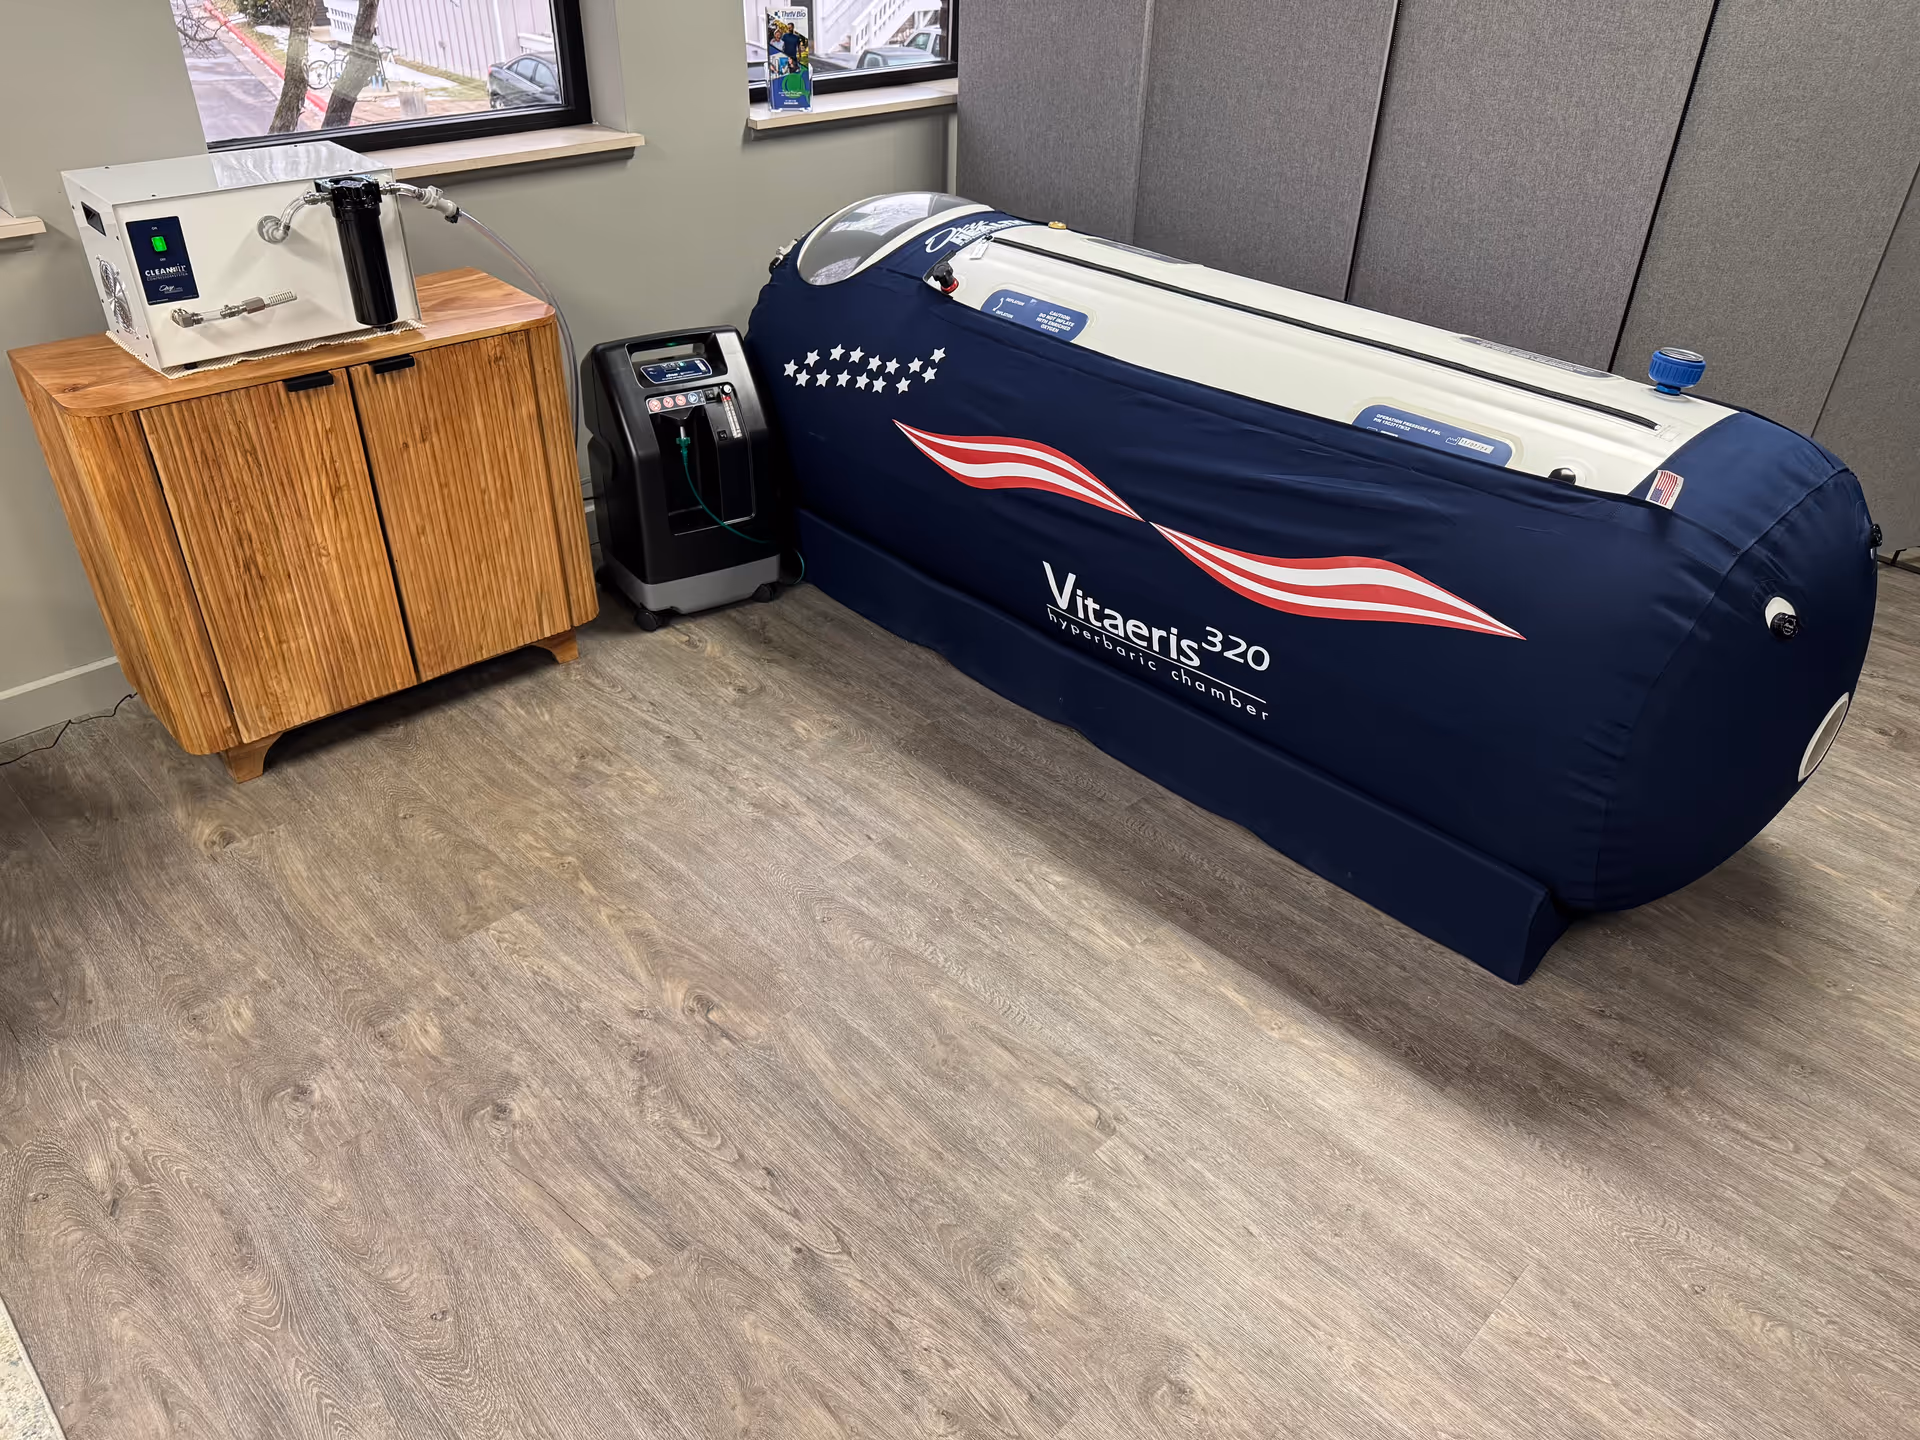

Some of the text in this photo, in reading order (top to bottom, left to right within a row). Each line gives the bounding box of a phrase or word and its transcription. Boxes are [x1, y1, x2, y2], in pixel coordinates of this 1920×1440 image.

[1040, 324, 1059, 333] OXYGEN
[1046, 314, 1056, 322] NOT
[1056, 318, 1075, 327] INFLATE
[1376, 414, 1403, 425] OPERATION
[1403, 420, 1428, 432] PRESSURE
[1042, 561, 1270, 671] Vitaeris 320
[1047, 607, 1269, 720] hyperbaric chamber
